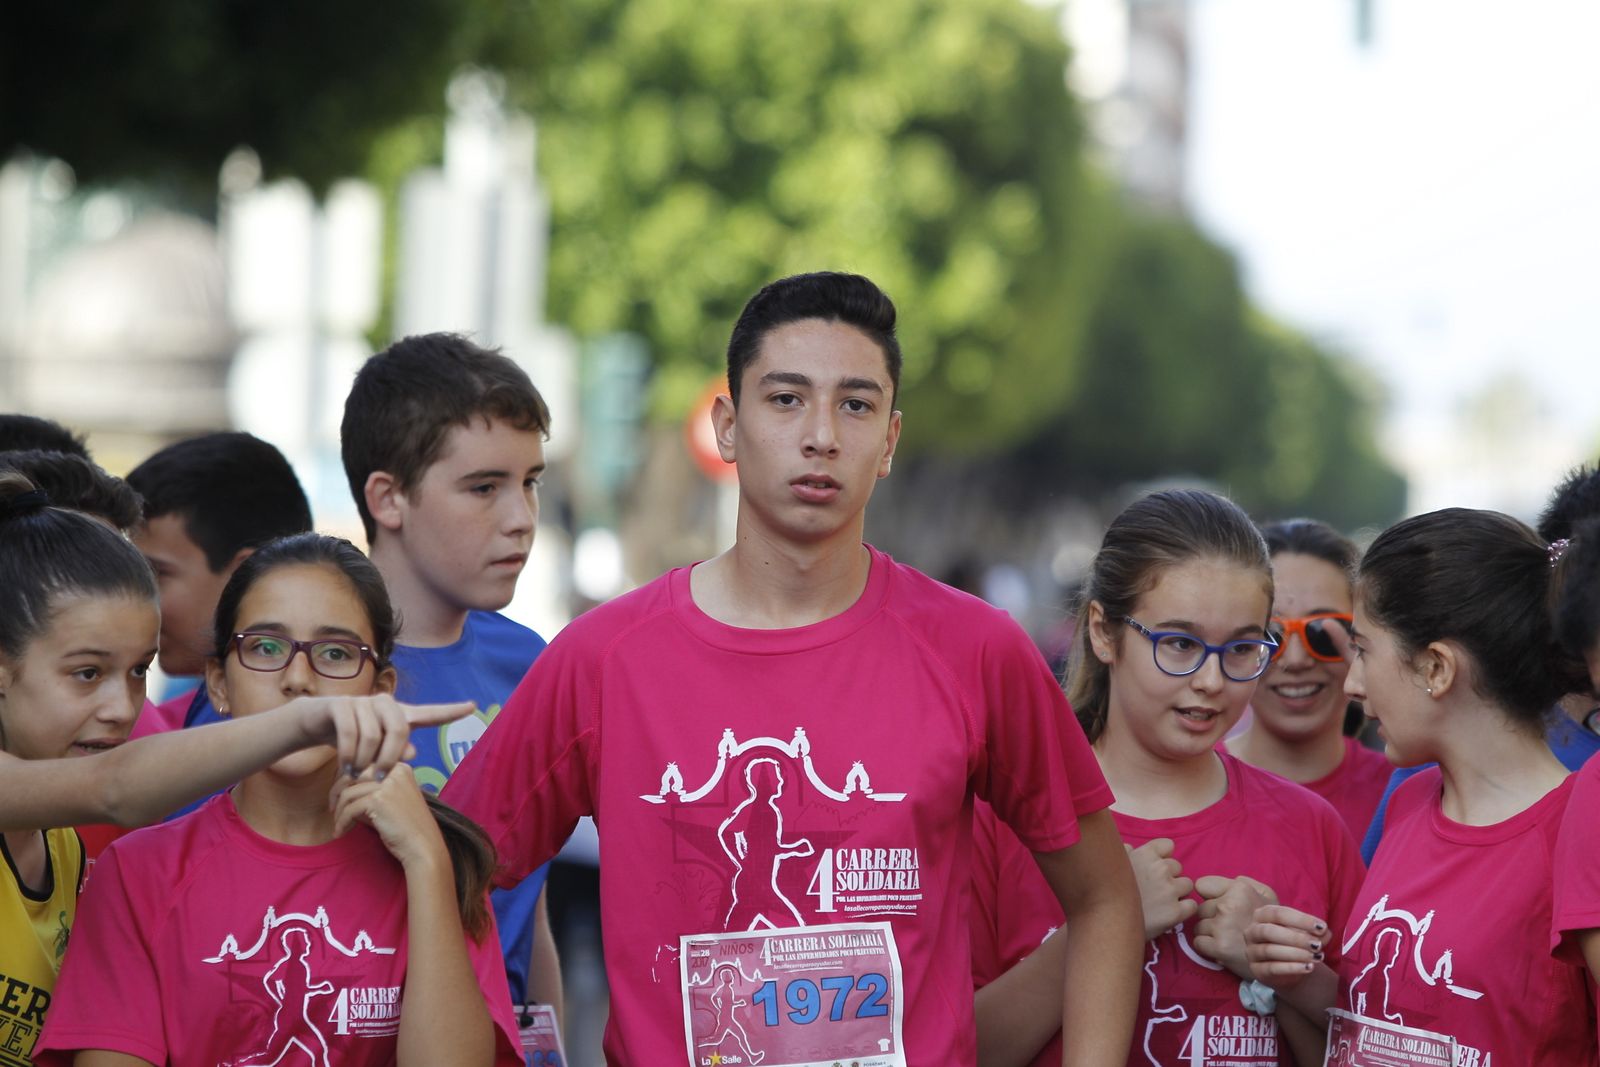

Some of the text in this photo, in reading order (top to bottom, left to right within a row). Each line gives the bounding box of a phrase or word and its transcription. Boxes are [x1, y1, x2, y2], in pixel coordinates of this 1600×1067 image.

[806, 847, 919, 913] 4 CARRERA
[836, 870, 920, 891] SOLIDARIA
[700, 949, 711, 957] 28
[720, 943, 754, 956] NIÑOS
[759, 933, 884, 967] 4 CARRERA SOLIDARIA
[328, 988, 353, 1035] 4
[752, 973, 889, 1027] 1972
[1178, 1015, 1211, 1067] 4
[1365, 1029, 1400, 1050] CARRERA
[1401, 1038, 1450, 1060] SOLIDARIA
[701, 1056, 742, 1067] La Salle
